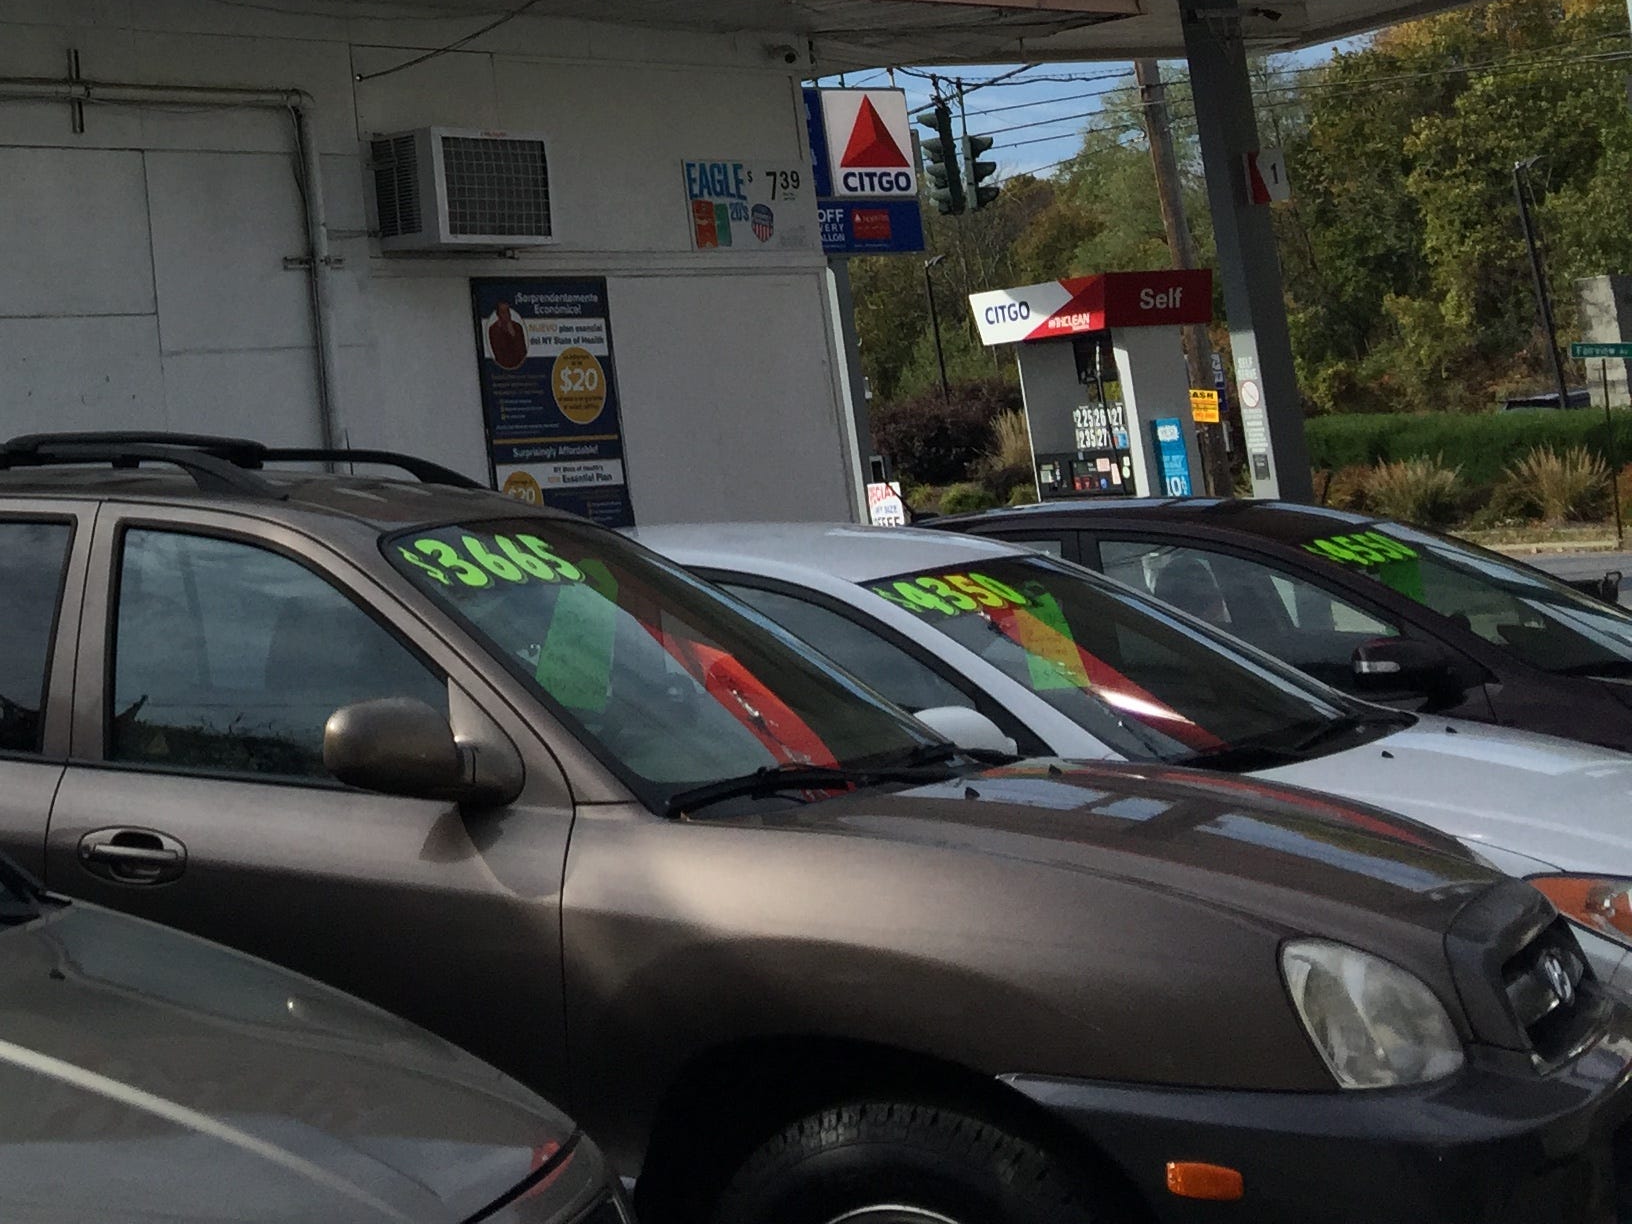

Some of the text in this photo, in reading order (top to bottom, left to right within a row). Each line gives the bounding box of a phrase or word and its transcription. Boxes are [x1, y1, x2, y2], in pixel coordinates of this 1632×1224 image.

[685, 162, 748, 201] EAGLE
[843, 171, 912, 193] CITGO
[818, 209, 844, 223] OFF
[818, 224, 844, 233] VERY
[820, 233, 846, 242] ALLON
[1139, 287, 1183, 310] Self
[985, 301, 1030, 325] CITGO
[560, 366, 598, 392] $20
[1190, 390, 1214, 400] ASH
[397, 533, 585, 589] $3665
[872, 571, 1032, 616] $4350
